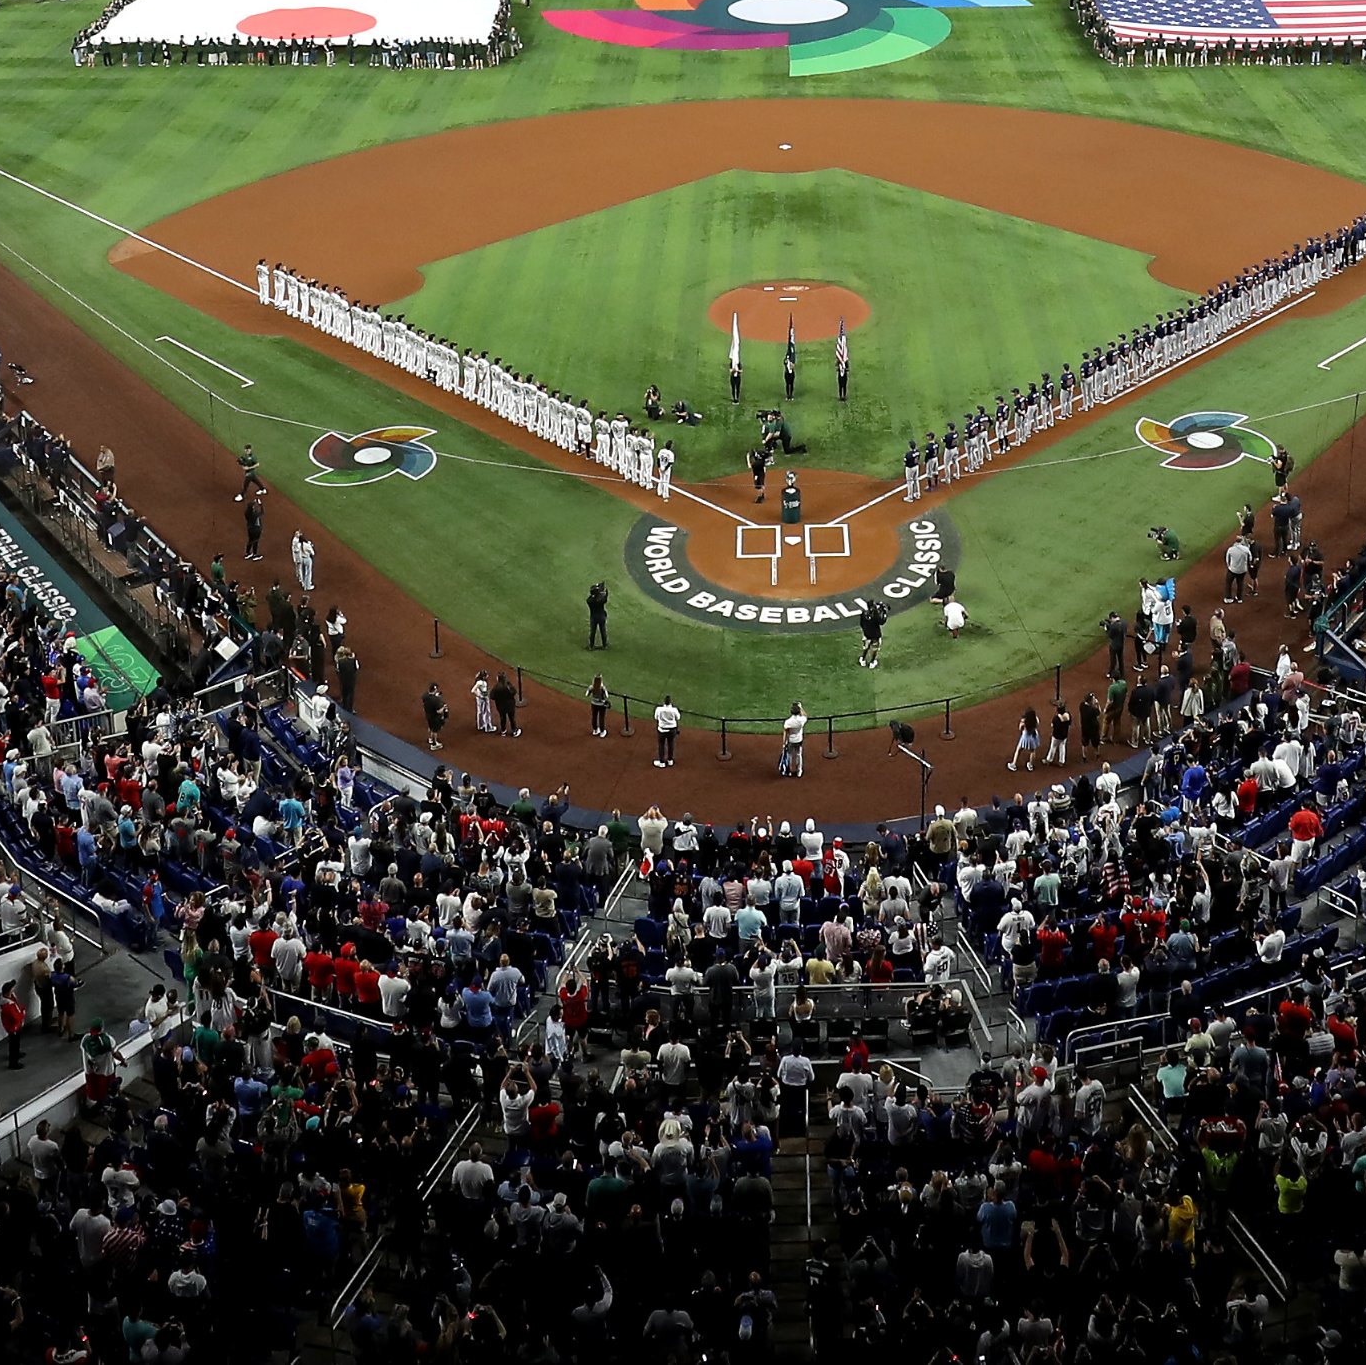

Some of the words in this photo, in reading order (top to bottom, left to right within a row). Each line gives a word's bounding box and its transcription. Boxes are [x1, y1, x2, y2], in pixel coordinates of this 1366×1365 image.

[17, 565, 78, 622] CLASSIC
[643, 526, 690, 594] WORLD
[882, 520, 942, 599] CLASSIC
